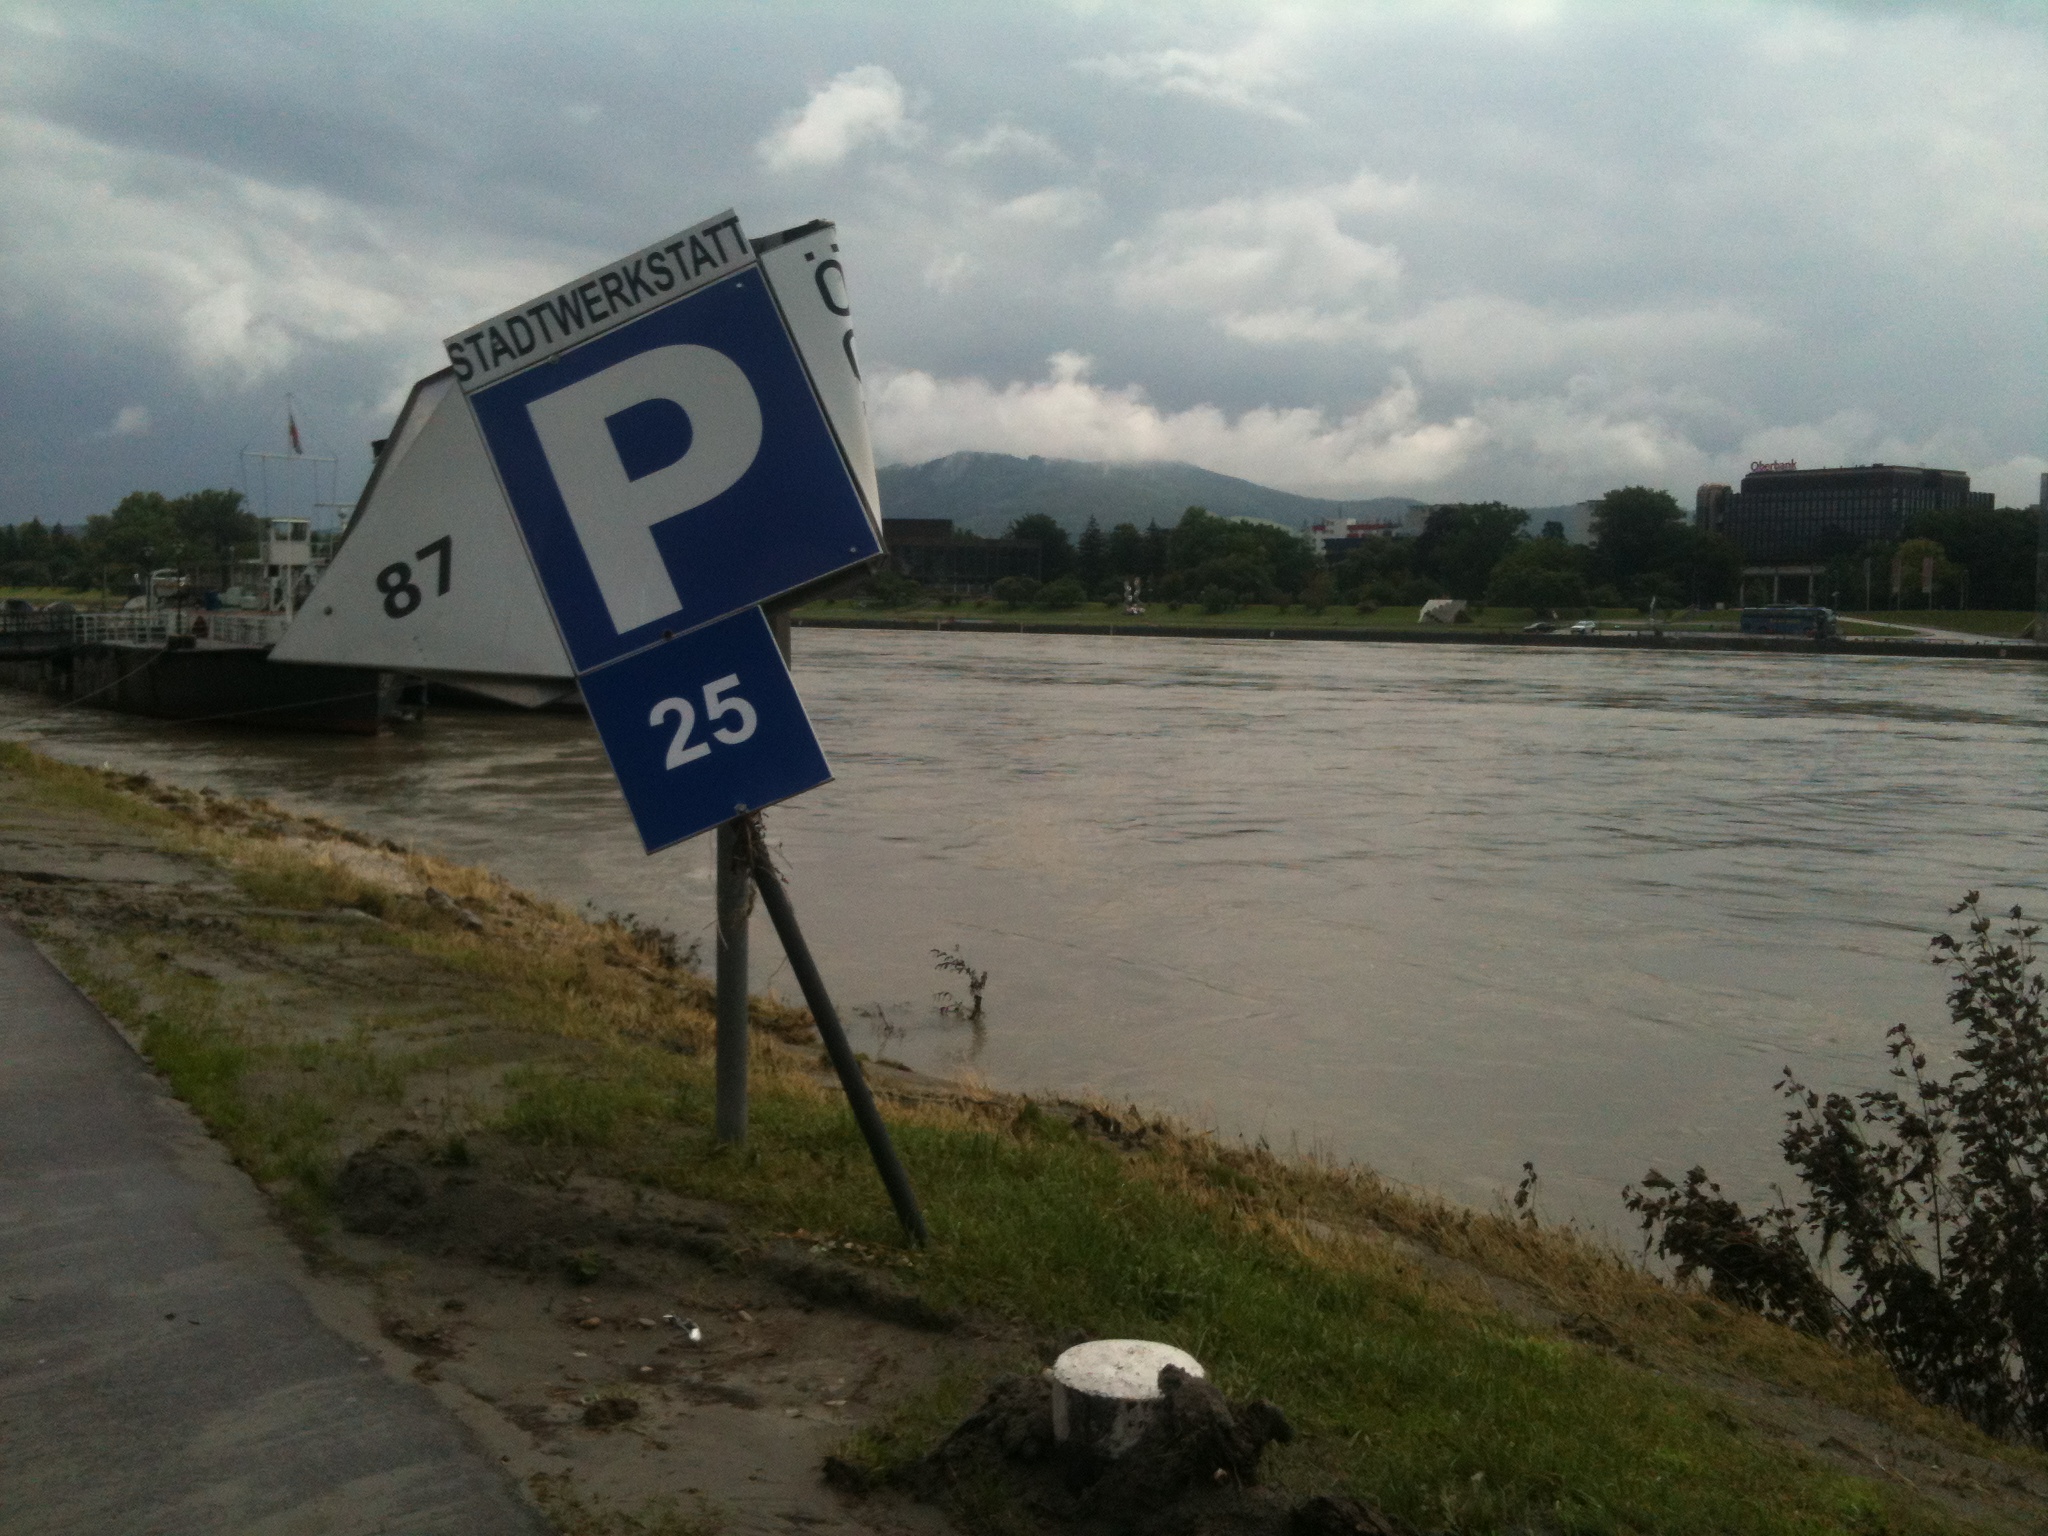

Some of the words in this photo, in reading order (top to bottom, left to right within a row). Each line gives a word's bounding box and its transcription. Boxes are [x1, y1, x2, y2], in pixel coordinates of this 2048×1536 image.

[447, 216, 749, 382] STADTWERKSTATT
[525, 343, 763, 635] P
[1751, 459, 1797, 471] Oberbank
[376, 535, 453, 619] 87
[649, 673, 757, 771] 25
